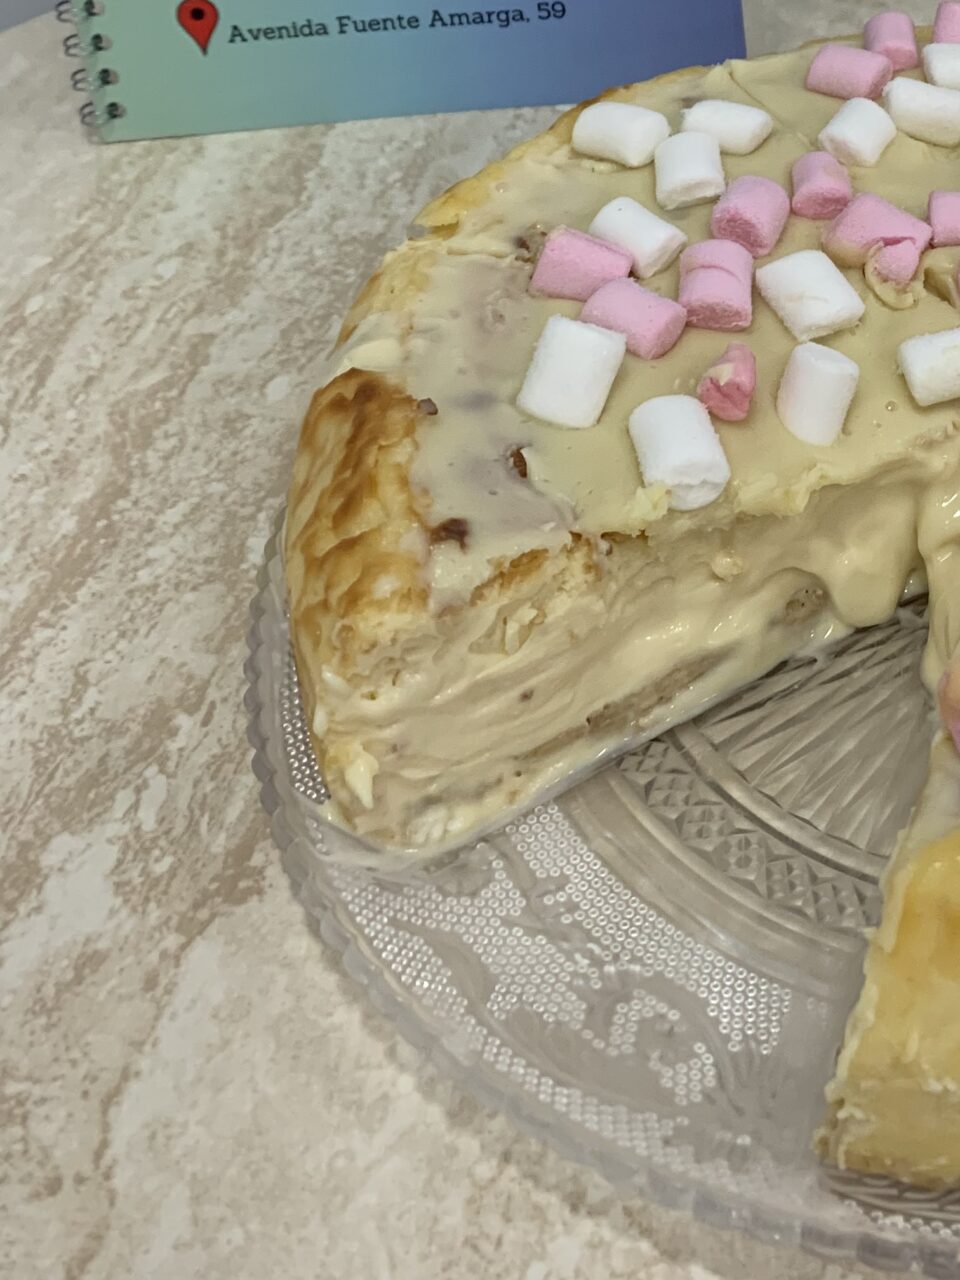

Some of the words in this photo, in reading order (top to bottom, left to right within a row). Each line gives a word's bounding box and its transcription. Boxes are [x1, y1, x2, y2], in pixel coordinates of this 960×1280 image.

[227, 20, 329, 44] Avenida
[336, 13, 420, 34] Fuente
[428, 6, 530, 30] Amarga,
[537, 0, 567, 21] 59
